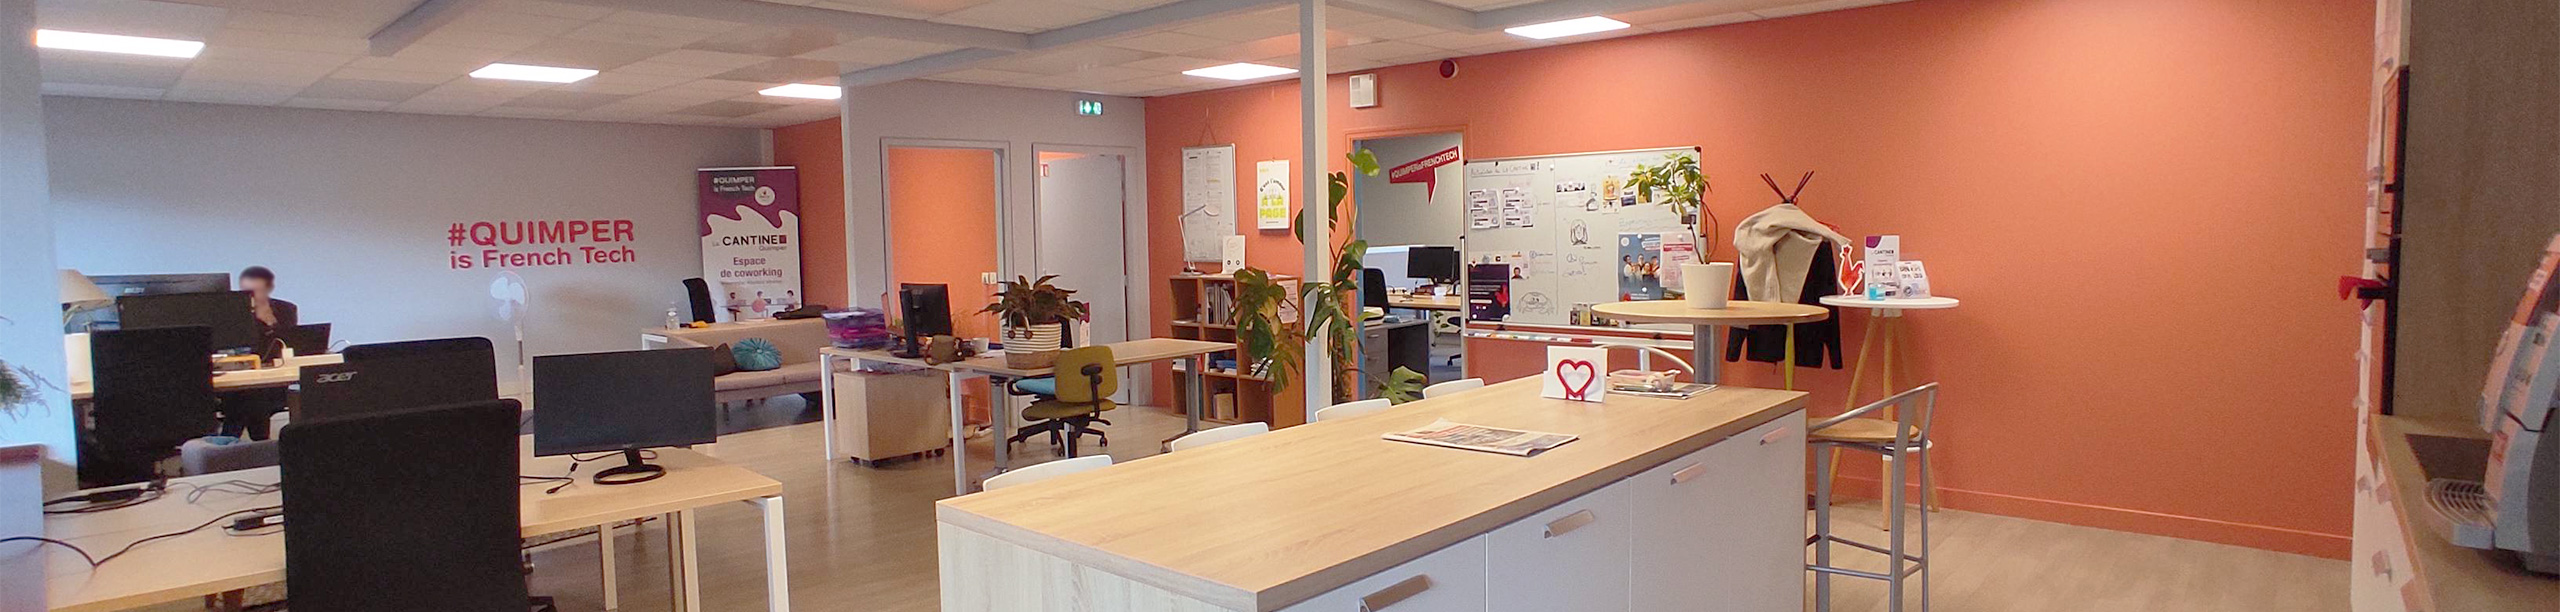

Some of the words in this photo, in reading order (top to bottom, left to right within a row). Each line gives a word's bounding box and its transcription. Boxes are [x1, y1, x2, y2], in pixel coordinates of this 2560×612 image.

[713, 176, 755, 184] #QUIMPER
[1259, 207, 1286, 218] PAGE
[448, 220, 634, 247] #QUIMPER
[722, 235, 778, 246] CANTINE
[450, 251, 472, 269] is
[483, 247, 571, 268] French
[580, 245, 635, 264] Tech
[733, 257, 766, 267] Espace
[720, 269, 732, 278] de
[734, 267, 783, 278] coworking
[316, 371, 358, 383] acer
